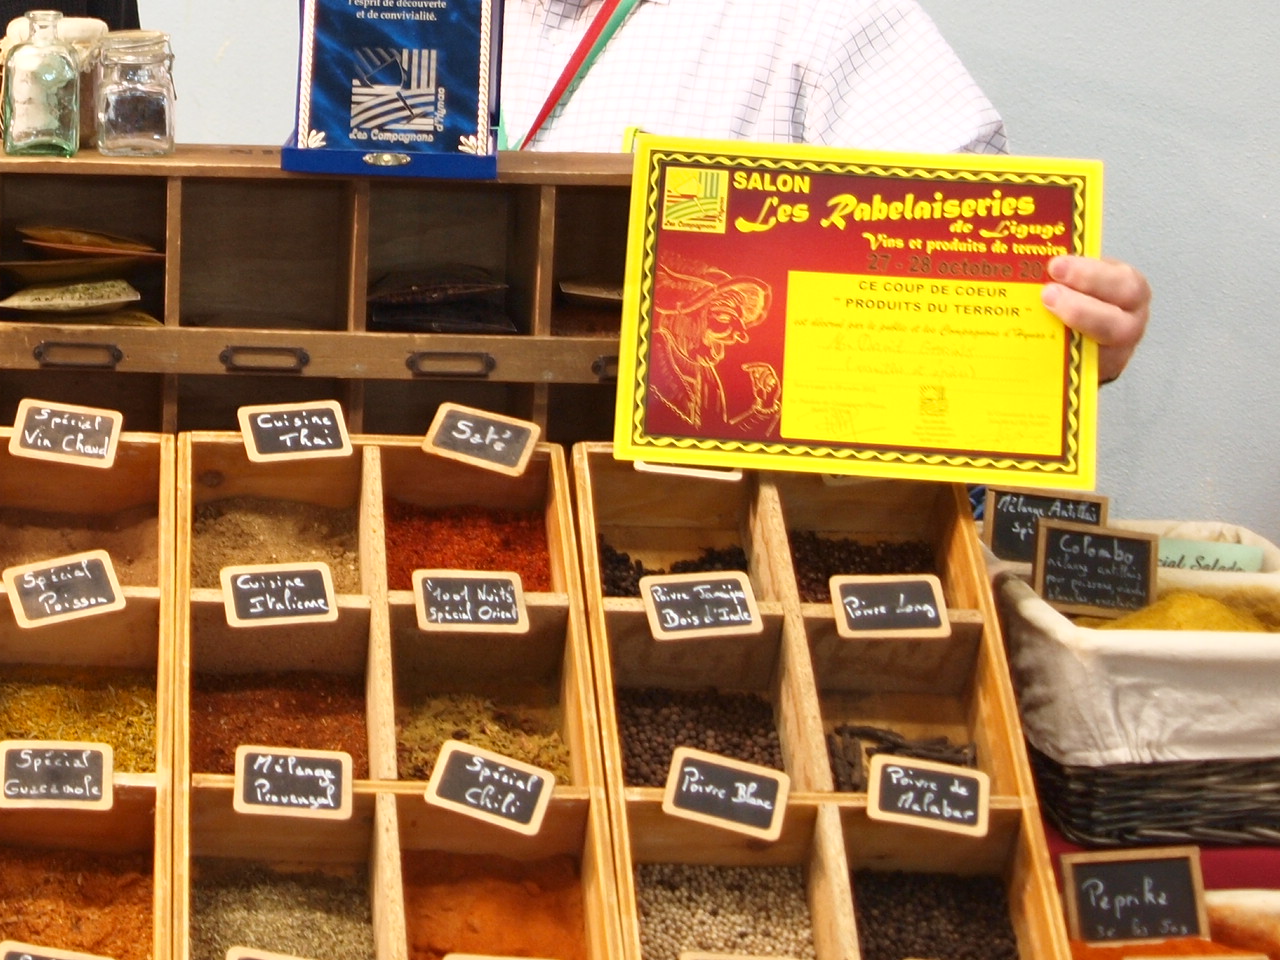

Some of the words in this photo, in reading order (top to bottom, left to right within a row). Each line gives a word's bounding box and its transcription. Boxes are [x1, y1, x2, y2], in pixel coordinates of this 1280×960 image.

[356, 11, 365, 19] et
[367, 10, 379, 20] de
[380, 11, 437, 21] convivialité.
[349, 126, 368, 140] Les
[370, 130, 434, 144] Compagnons
[733, 171, 811, 193] SALON
[734, 196, 811, 233] Les
[820, 189, 1036, 231] Rabelaiseries
[949, 220, 974, 235] de
[978, 220, 1066, 240] Ligugé
[862, 231, 905, 252] Vins
[908, 237, 922, 250] et
[925, 237, 988, 255] produits
[991, 240, 1009, 254] de
[1012, 243, 1068, 257] terroirs
[868, 253, 892, 271] 27
[909, 254, 932, 275] 28
[937, 257, 1014, 278] octobre
[859, 281, 878, 292] CE
[883, 282, 925, 295] COUP
[930, 284, 949, 296] DE
[955, 286, 1008, 299] COEUR
[845, 298, 922, 313] PRODUITS
[927, 303, 948, 314] DU
[954, 304, 1021, 318] TERROIR
[256, 411, 332, 429] Cuisine
[24, 428, 52, 449] Vin
[61, 435, 111, 458] Chaud
[1059, 534, 1134, 564] Colombo
[236, 575, 305, 590] Cuisine
[650, 585, 690, 602] Poivre
[38, 591, 108, 614] Poisson
[843, 596, 887, 619] Poivre
[896, 593, 937, 619] Long
[661, 608, 700, 628] Bois
[15, 749, 92, 772] Spécial
[253, 755, 336, 787] Mélange
[4, 775, 101, 797] Guacamole
[465, 756, 539, 792] Spécial
[886, 765, 938, 792] Poivre
[949, 777, 970, 797] de
[464, 784, 520, 813] Chili
[682, 766, 726, 800] Poivre
[731, 781, 773, 810] Blanc
[896, 793, 975, 820] Malabar
[1082, 876, 1169, 918] Paprika
